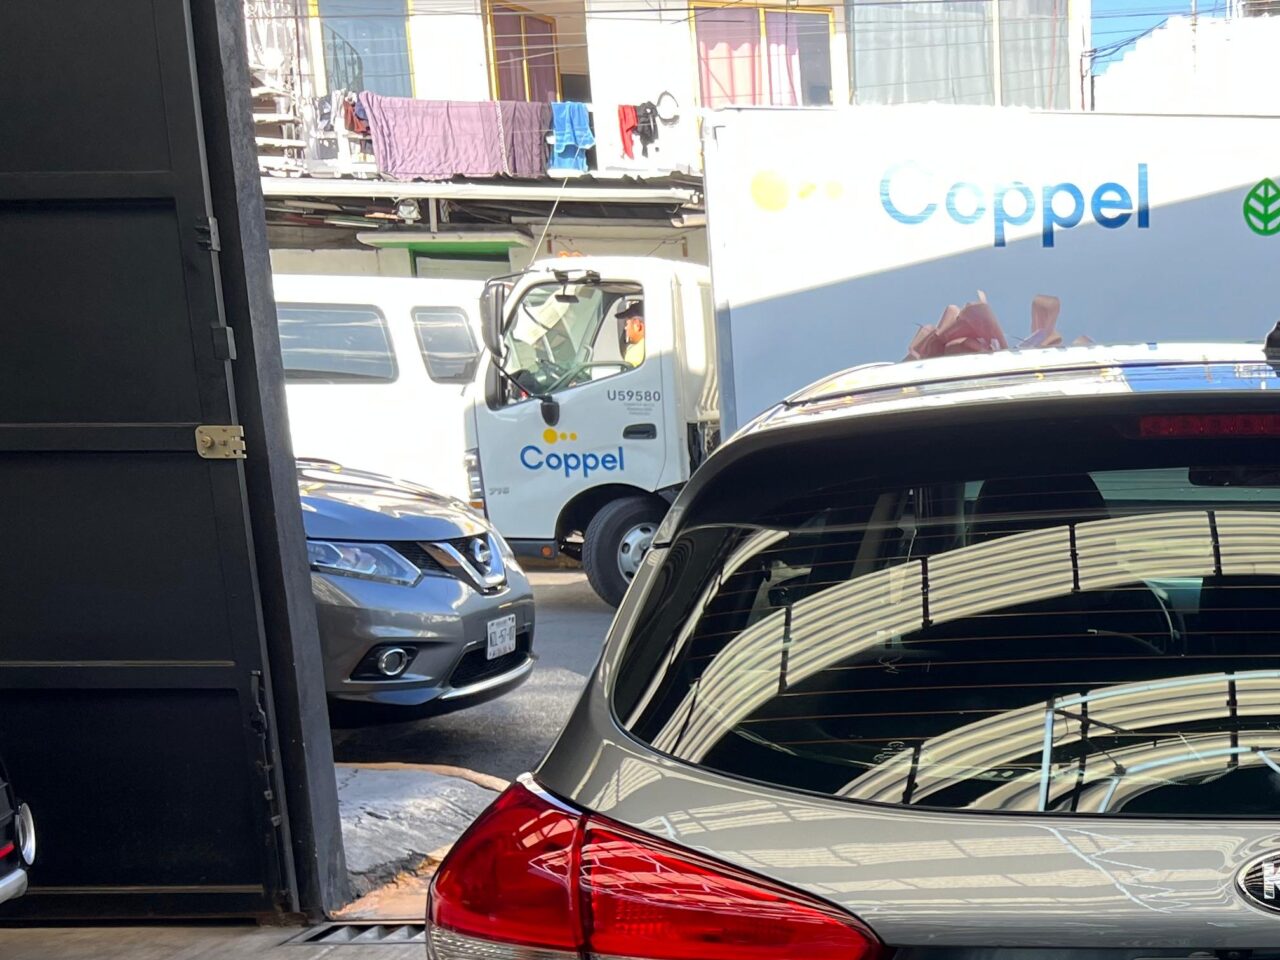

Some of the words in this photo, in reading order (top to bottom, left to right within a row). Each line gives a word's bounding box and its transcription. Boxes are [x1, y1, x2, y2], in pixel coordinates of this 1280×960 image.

[879, 160, 1150, 248] Coppel
[607, 389, 661, 402] U59580
[520, 445, 624, 478] Coppel
